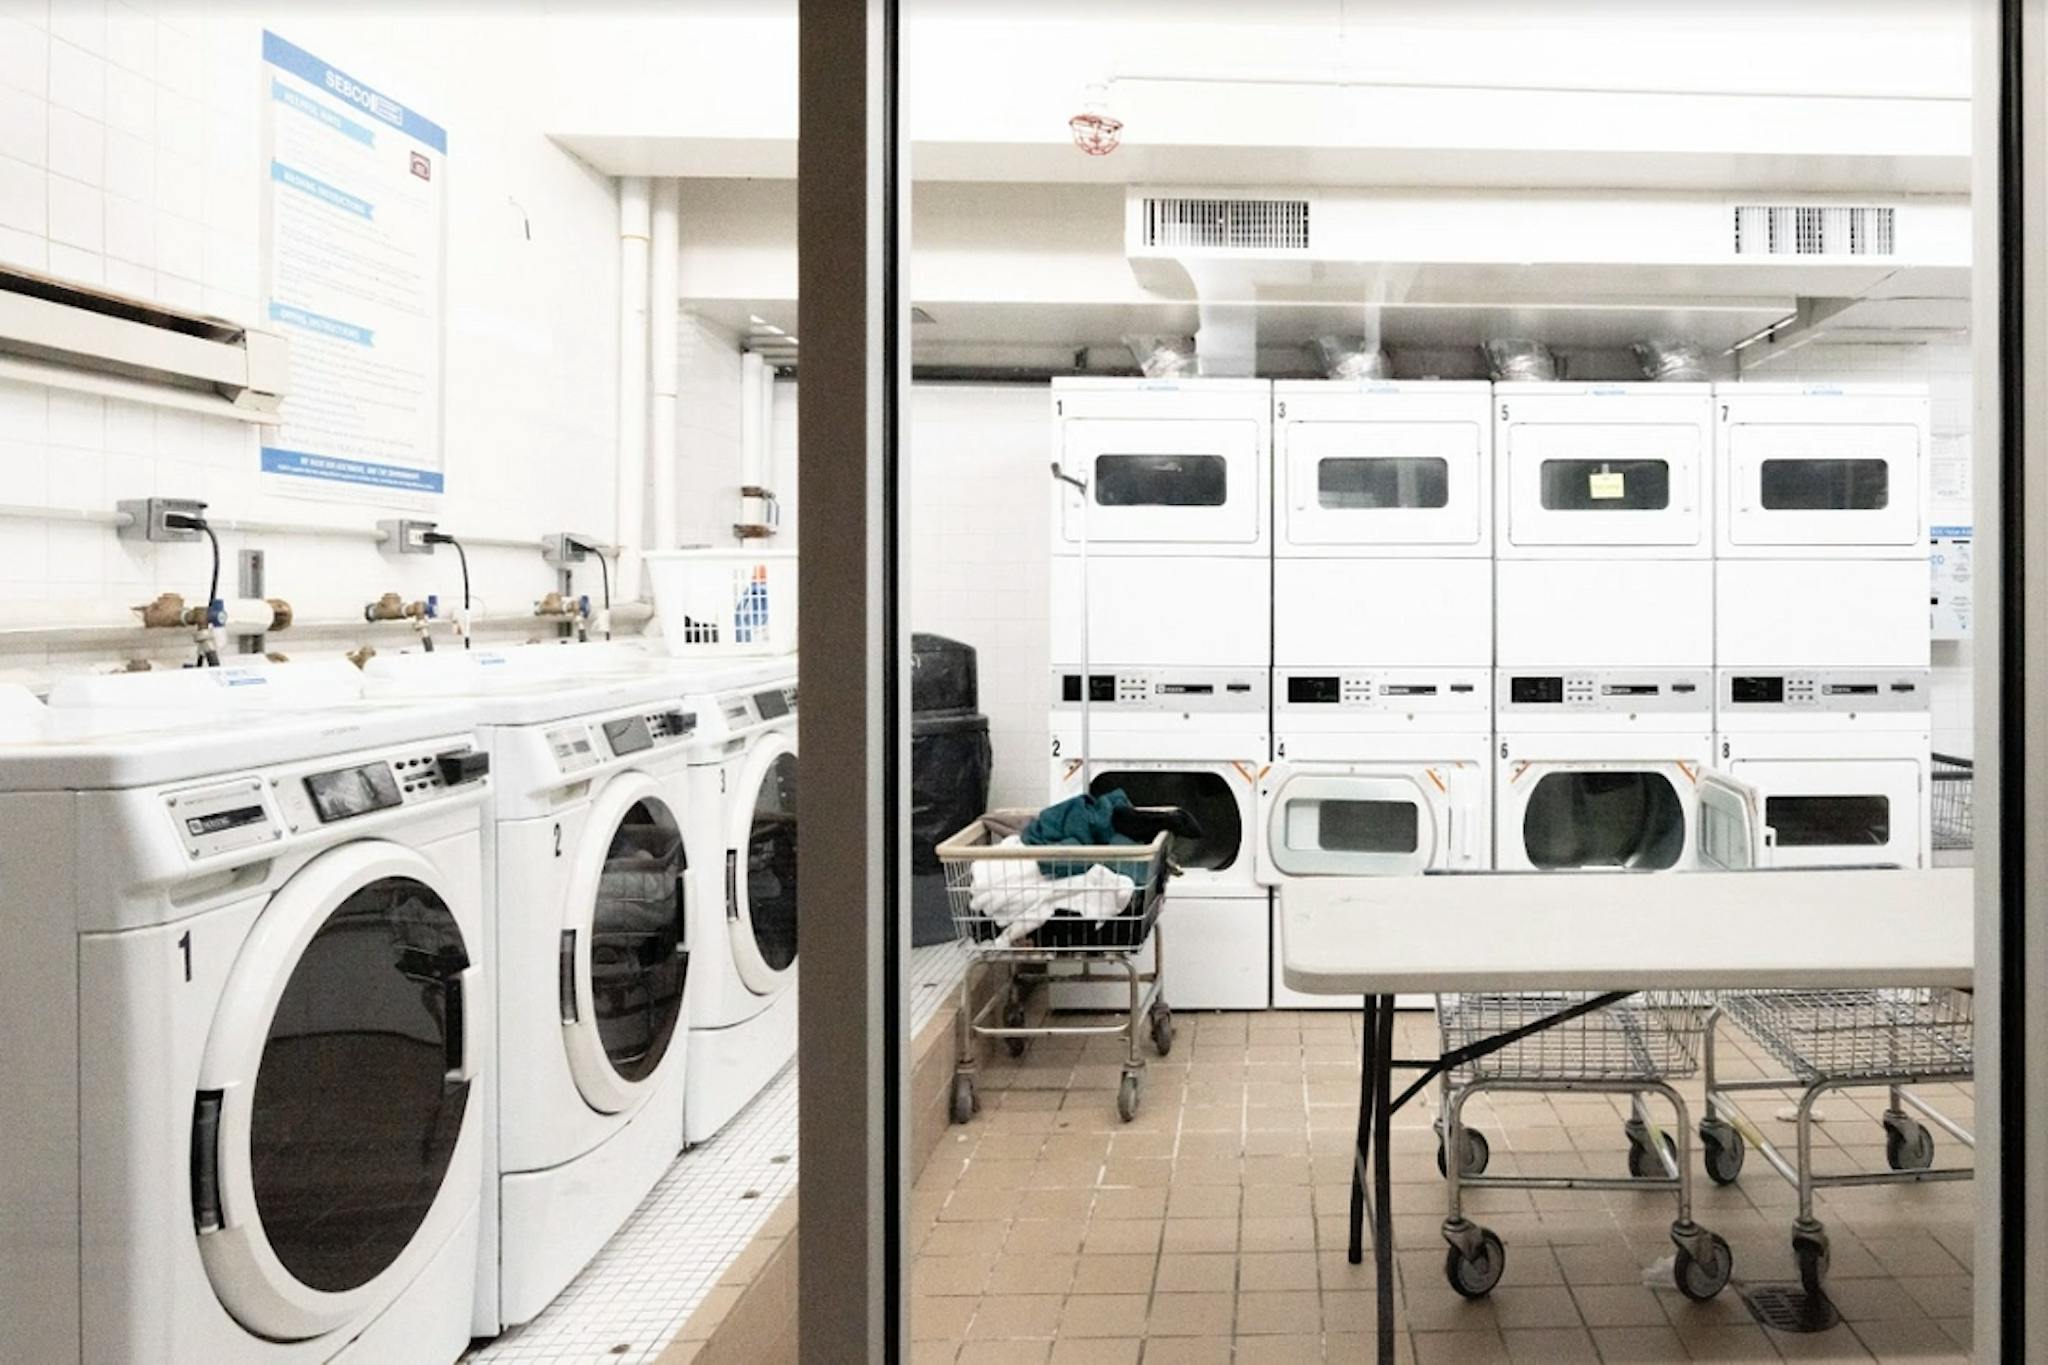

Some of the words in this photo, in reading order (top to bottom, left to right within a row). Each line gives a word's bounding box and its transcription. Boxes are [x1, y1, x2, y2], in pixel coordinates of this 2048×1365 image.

[1057, 400, 1063, 416] 1
[1278, 402, 1286, 418] 3
[1501, 404, 1509, 421] 5
[1721, 405, 1729, 422] 7
[1052, 739, 1061, 757] 2
[1278, 743, 1285, 758] 4
[1501, 743, 1508, 759] 6
[1723, 742, 1730, 759] 8
[553, 822, 561, 857] 2
[178, 930, 191, 982] 1
